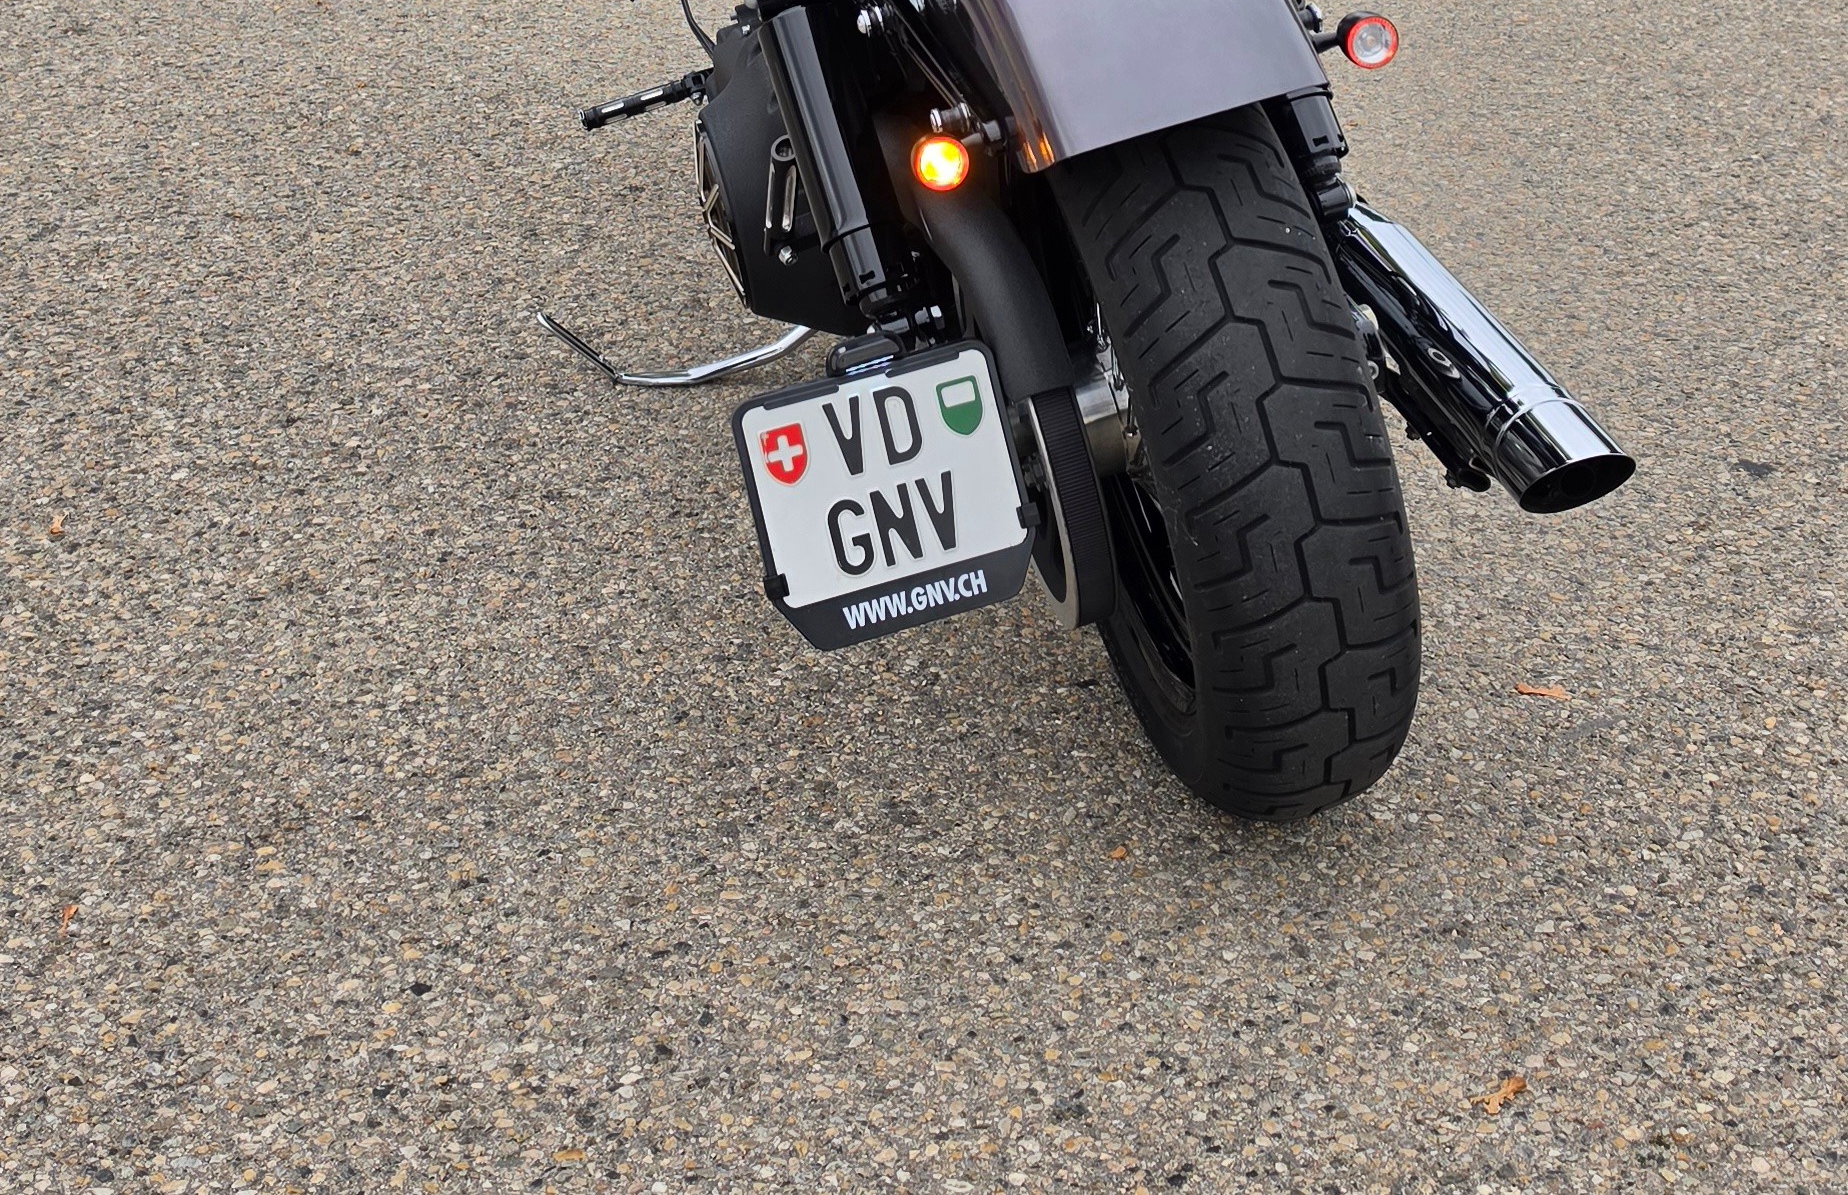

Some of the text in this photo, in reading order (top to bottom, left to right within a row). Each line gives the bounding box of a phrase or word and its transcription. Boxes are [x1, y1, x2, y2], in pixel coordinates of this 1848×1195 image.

[822, 386, 923, 476] VD
[827, 470, 957, 576] GNV
[842, 569, 988, 630] WWW.GNV.CH
